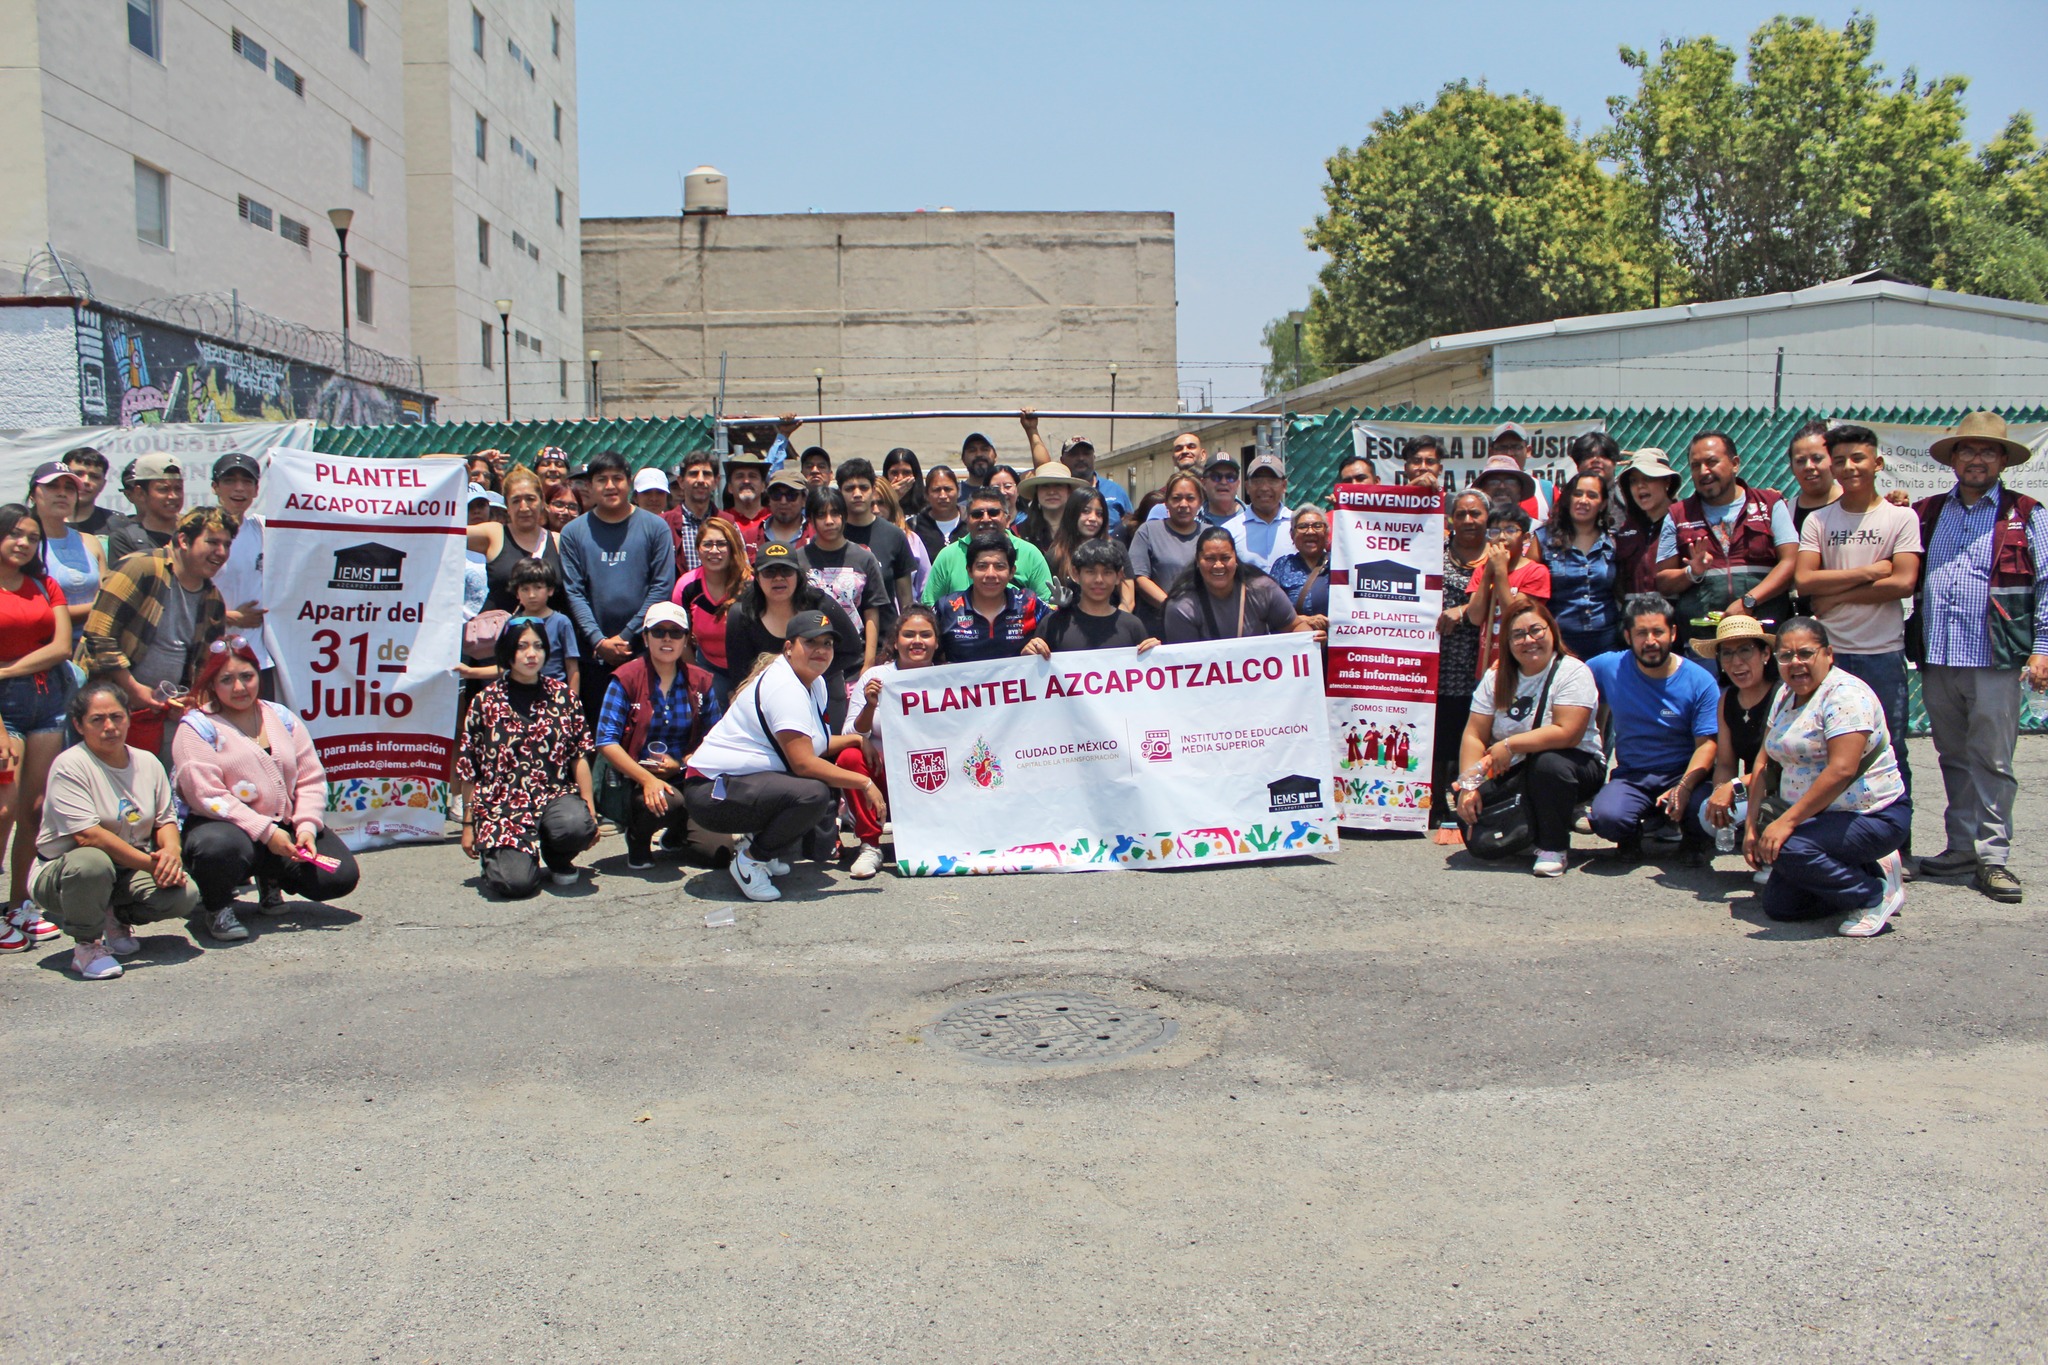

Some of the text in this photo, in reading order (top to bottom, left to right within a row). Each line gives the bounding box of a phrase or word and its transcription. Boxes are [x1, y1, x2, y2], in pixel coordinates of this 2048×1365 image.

[1896, 445, 1930, 458] Orque
[315, 463, 426, 487] PLANTEL
[1922, 462, 1935, 473] de
[1881, 478, 1892, 488] te
[1895, 477, 1924, 488] invita
[1928, 480, 1934, 488] a
[2010, 478, 2023, 488] de
[285, 493, 456, 516] AZCAPOTZALCO II
[1339, 492, 1441, 508] BIENVENIDOS
[1355, 521, 1424, 533] A LA NUEVA
[1366, 536, 1411, 552] SEDE
[338, 567, 371, 580] IEMS
[1360, 578, 1389, 591] IEMS
[1360, 592, 1406, 600] AZCAPOTZALCO
[297, 600, 424, 624] Apartir del
[1352, 610, 1420, 624] DEL PLANTEL
[1336, 625, 1435, 640] AZCAPOTZALCO II
[310, 629, 409, 676] 31 de
[1347, 652, 1421, 667] Consulta para
[1339, 669, 1428, 684] más información
[901, 654, 1310, 716] PLANTEL AZCAPOTZALCO II
[301, 680, 413, 721] Julio
[1351, 704, 1408, 714] ¡SOMOS IEMS!
[1181, 724, 1308, 743] INSTITUTO DE EDUCACIÓN
[324, 745, 346, 759] para
[348, 741, 373, 752] más
[376, 741, 446, 755] información
[1015, 740, 1118, 759] CIUDAD DE MÉXICO
[1182, 739, 1265, 754] MEDIA SUPERIOR
[1017, 760, 1041, 769] CAPITAL
[1062, 753, 1119, 764] TRANSFORMACIÓN
[1273, 793, 1298, 804] IEMS
